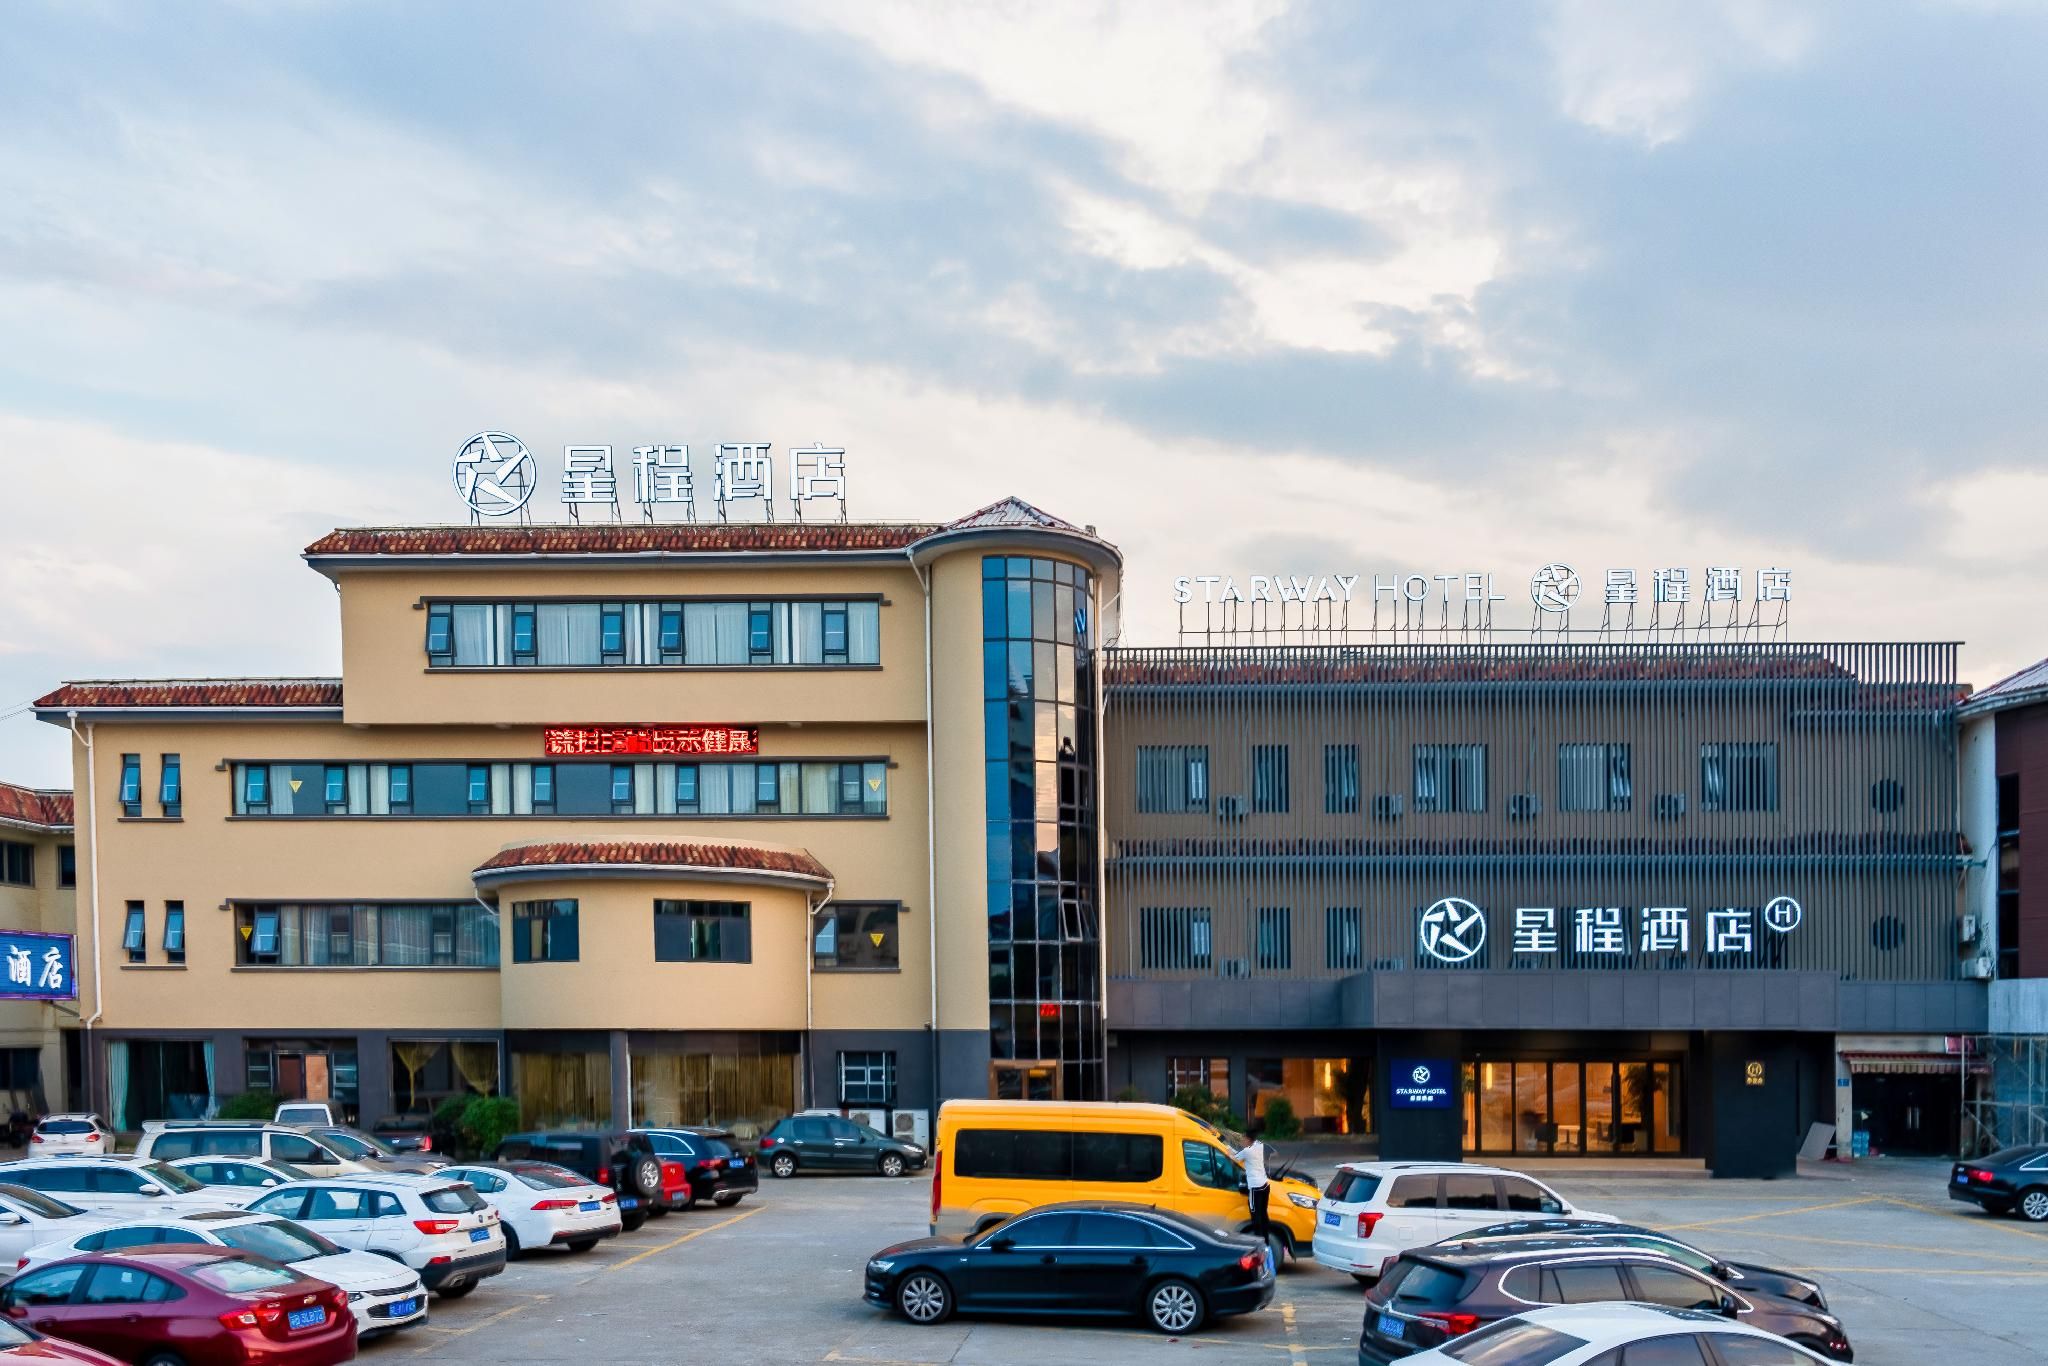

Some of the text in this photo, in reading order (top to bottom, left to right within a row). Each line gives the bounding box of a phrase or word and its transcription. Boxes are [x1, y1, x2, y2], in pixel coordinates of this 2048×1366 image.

[561, 442, 846, 503] 星程酒店
[1173, 573, 1506, 603] STARWAY HOTEL
[1604, 567, 1792, 605] 星程酒店
[1513, 907, 1752, 953] 星程酒店
[6, 944, 63, 989] 酒店
